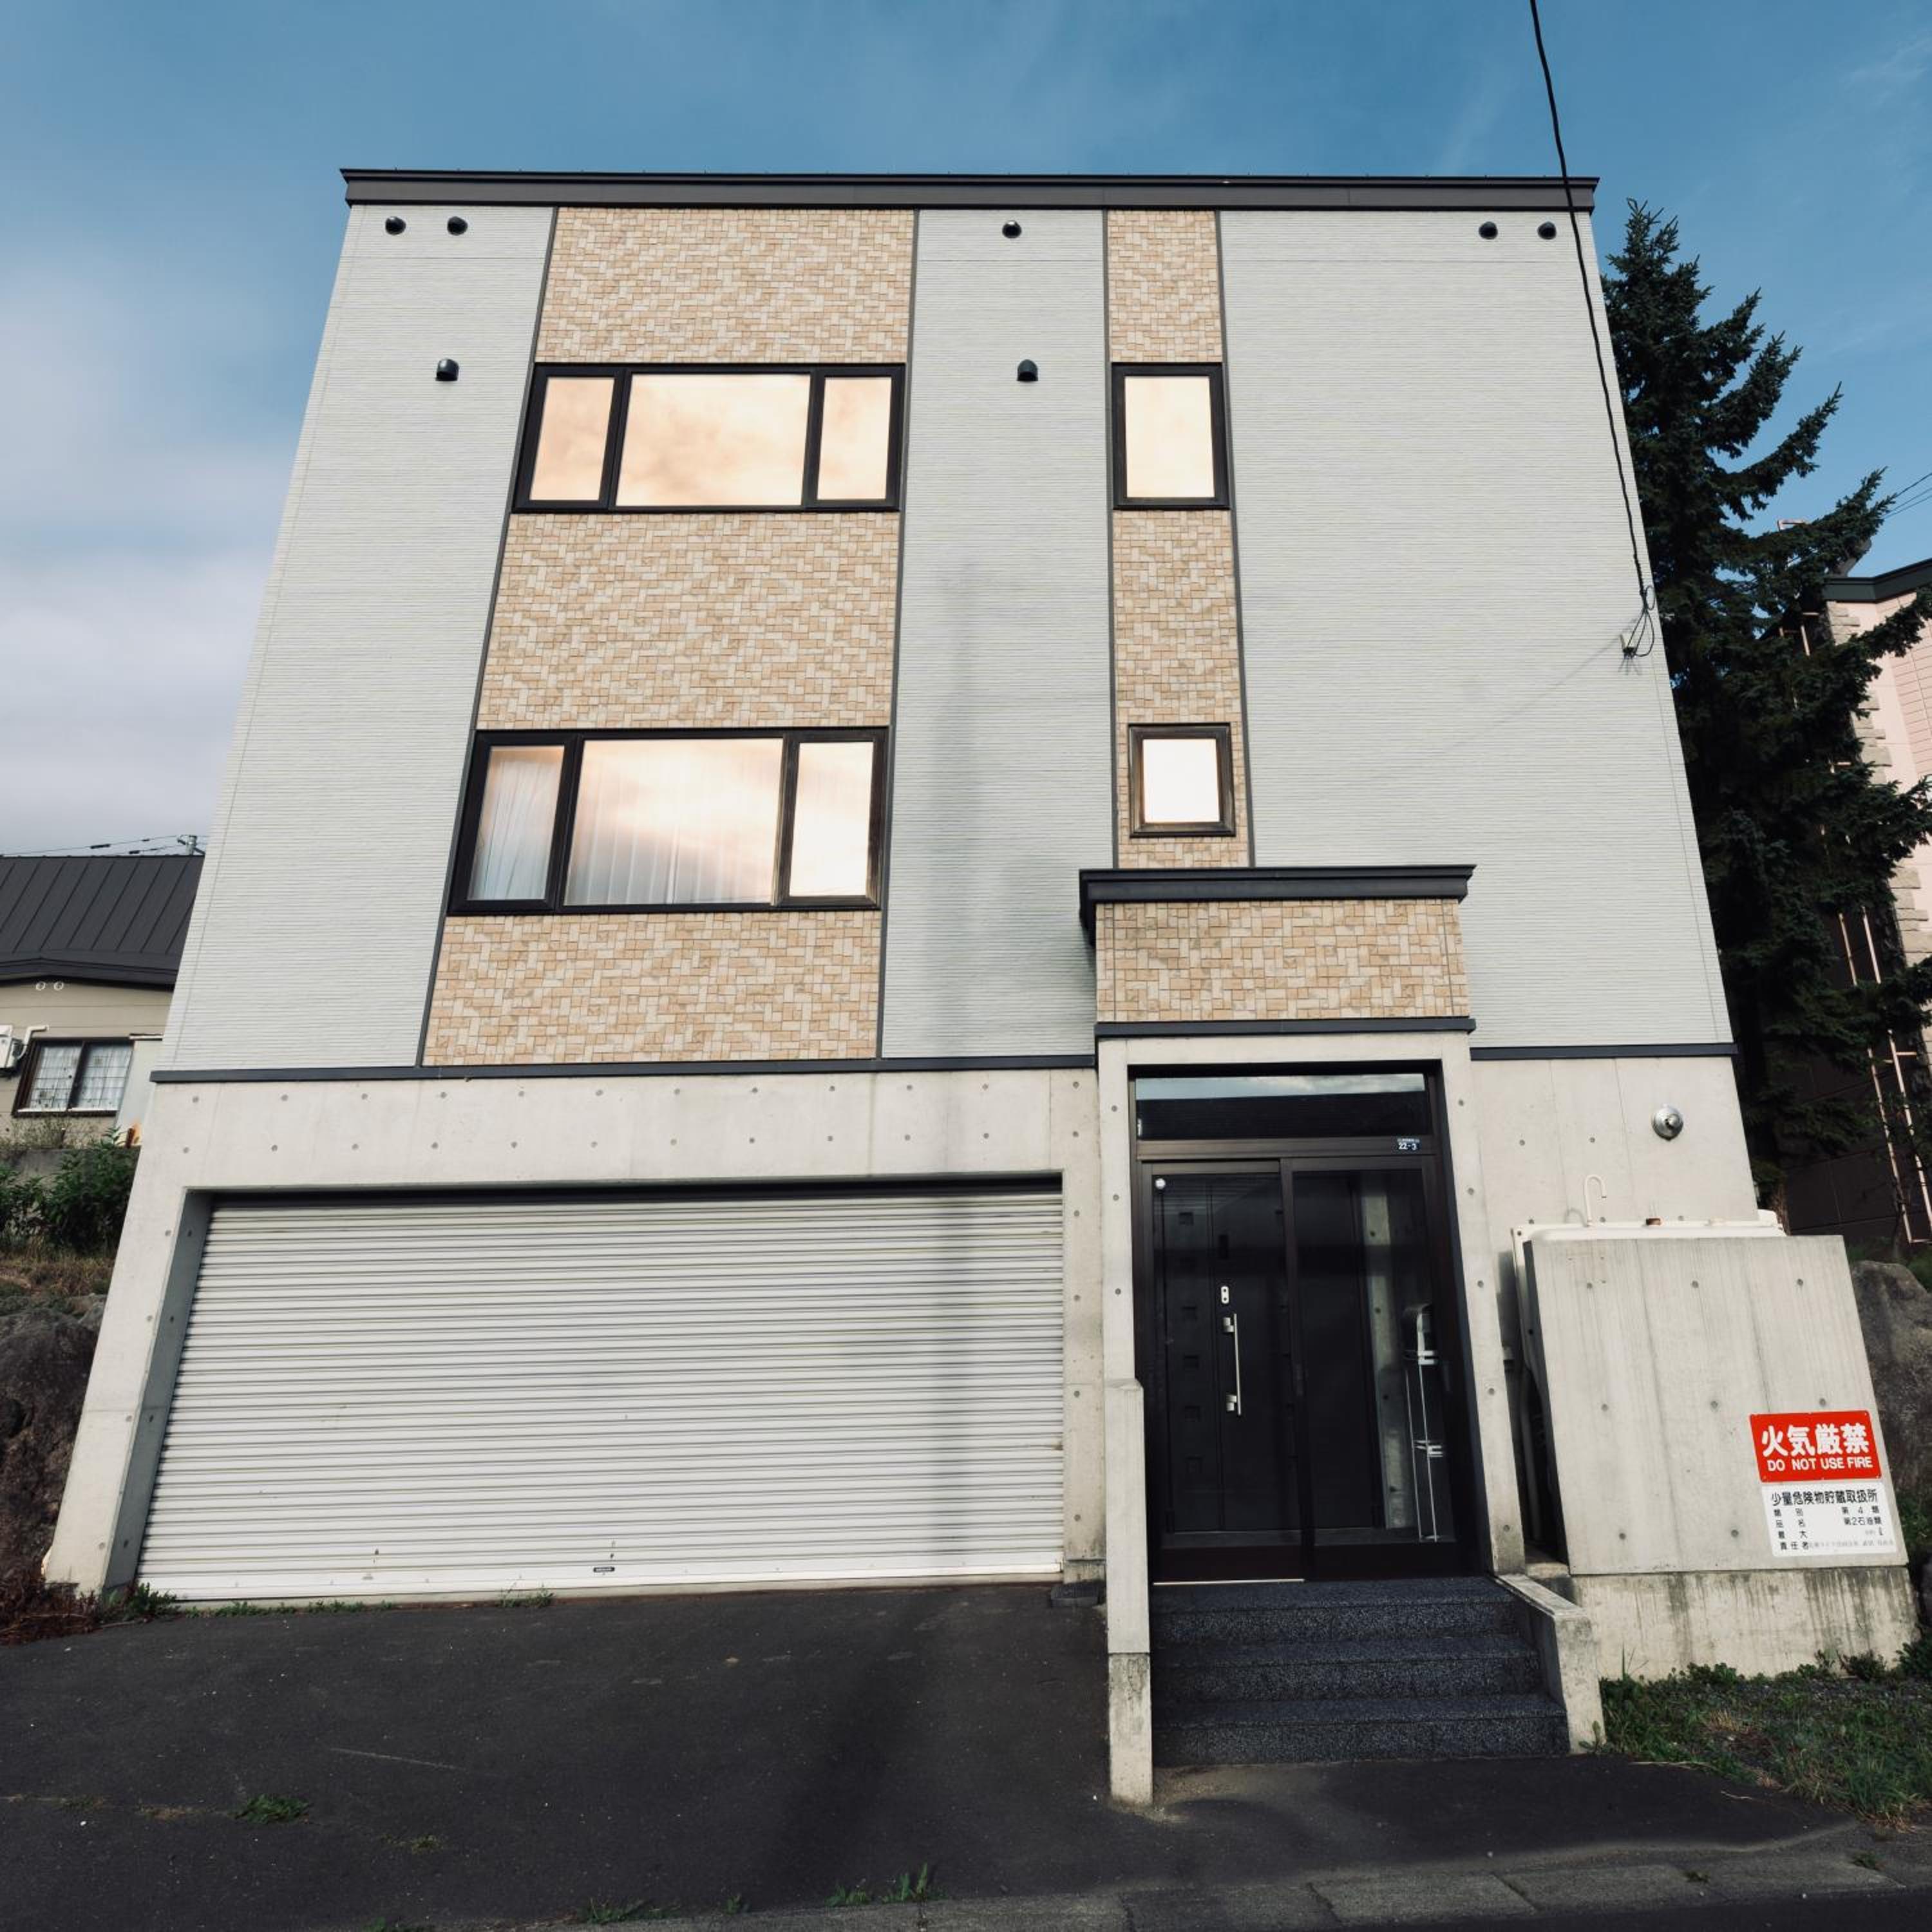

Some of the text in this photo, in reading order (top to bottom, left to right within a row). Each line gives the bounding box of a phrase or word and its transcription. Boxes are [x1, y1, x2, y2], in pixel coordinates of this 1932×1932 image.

[1761, 1423, 1870, 1458] 火気厳禁
[1767, 1456, 1873, 1472] DO NOT USE FIRE
[1772, 1488, 1879, 1506] 少量危険物貯蔵取扱所
